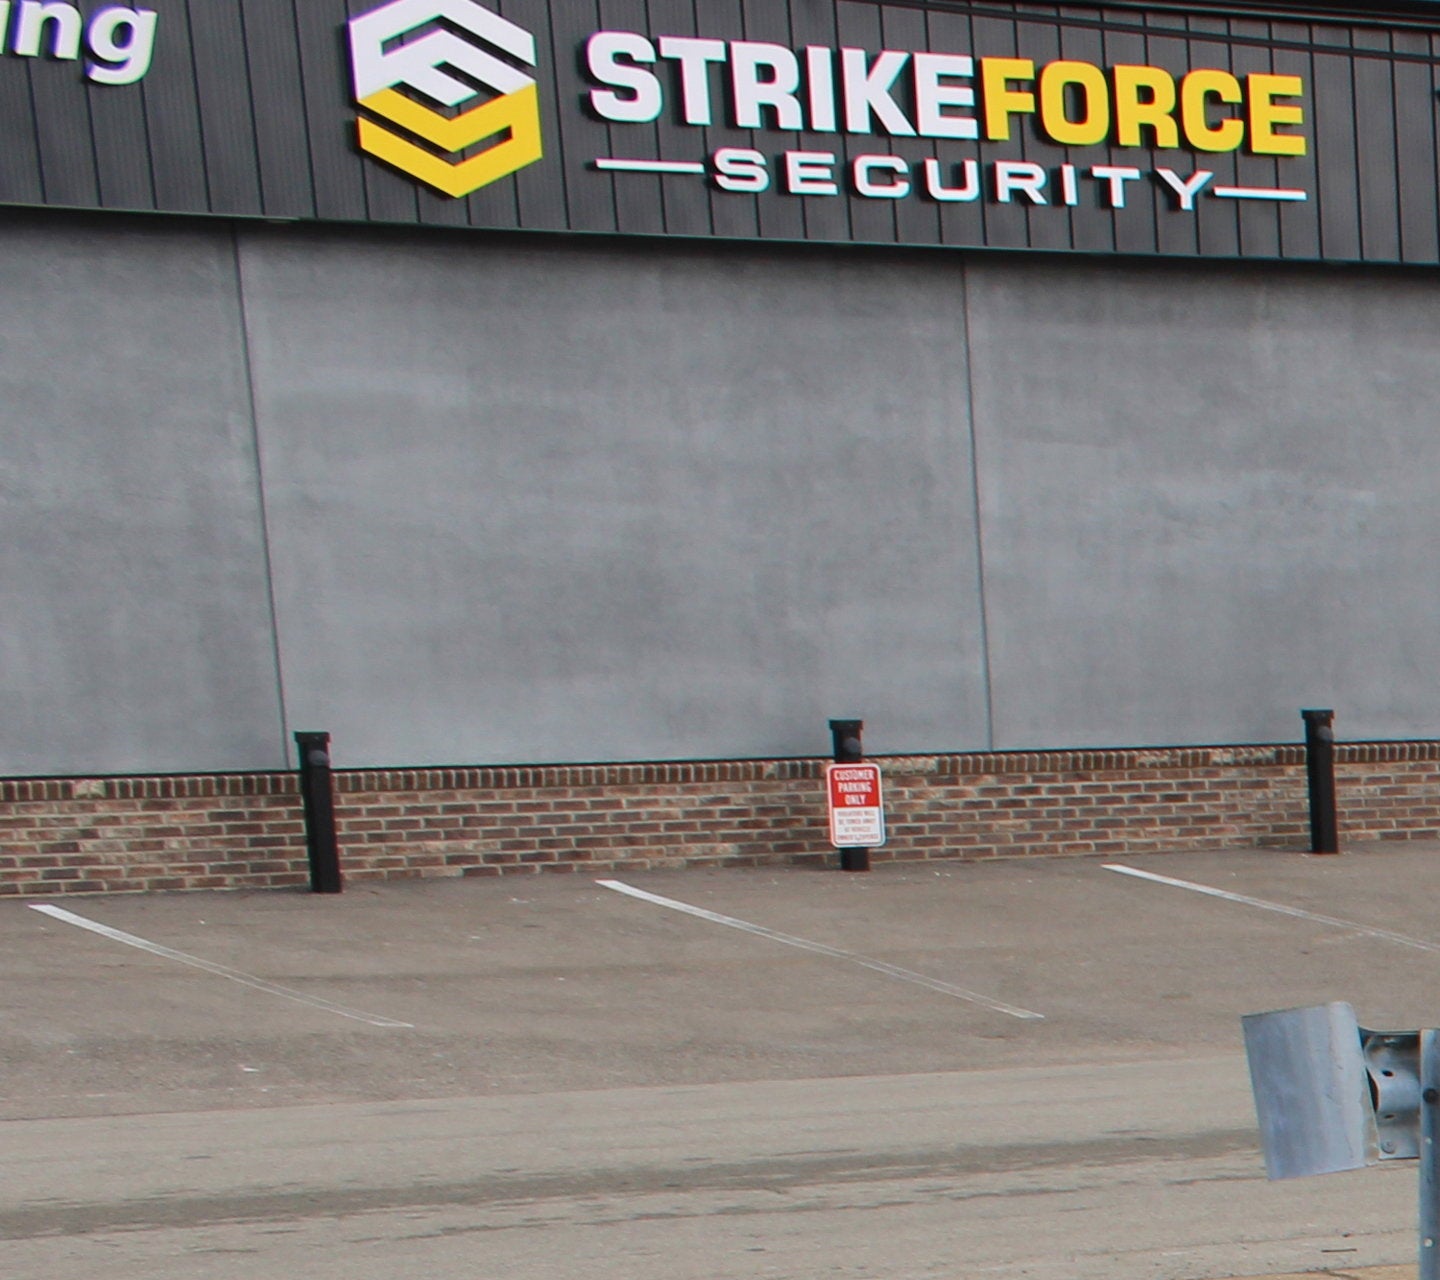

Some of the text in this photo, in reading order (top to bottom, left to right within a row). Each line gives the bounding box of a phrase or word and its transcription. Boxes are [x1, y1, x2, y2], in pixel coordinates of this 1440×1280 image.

[585, 31, 1308, 157] STRIKEFORCE
[712, 147, 1214, 211] SECURITY
[834, 769, 874, 781] CUSTOMER
[838, 782, 872, 793] PARKING
[845, 794, 866, 805] ONLY
